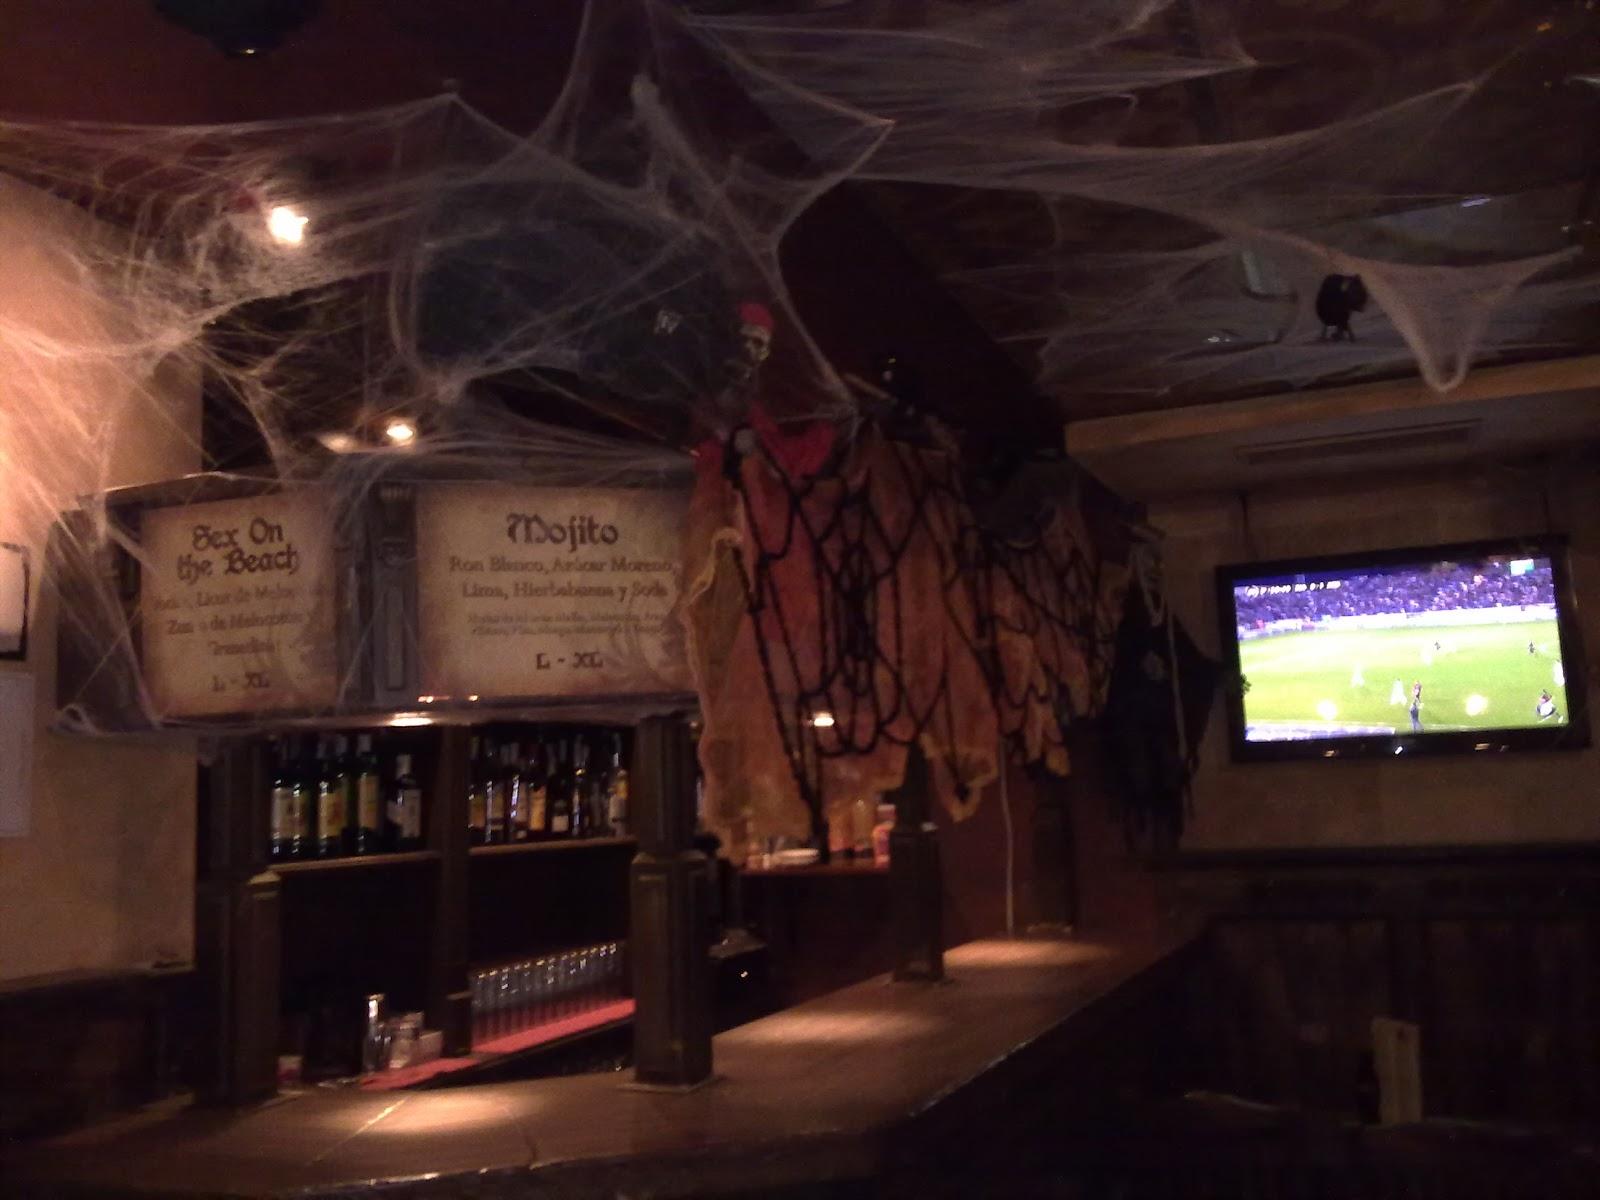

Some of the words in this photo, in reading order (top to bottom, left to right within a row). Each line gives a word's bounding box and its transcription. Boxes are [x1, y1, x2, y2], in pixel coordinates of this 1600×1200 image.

[192, 523, 239, 551] Sex
[249, 516, 284, 544] On
[506, 513, 618, 552] Mojito
[177, 553, 213, 585] the
[223, 544, 300, 575] Beach
[449, 555, 484, 572] Ron
[536, 653, 550, 670] L
[573, 651, 604, 668] XL
